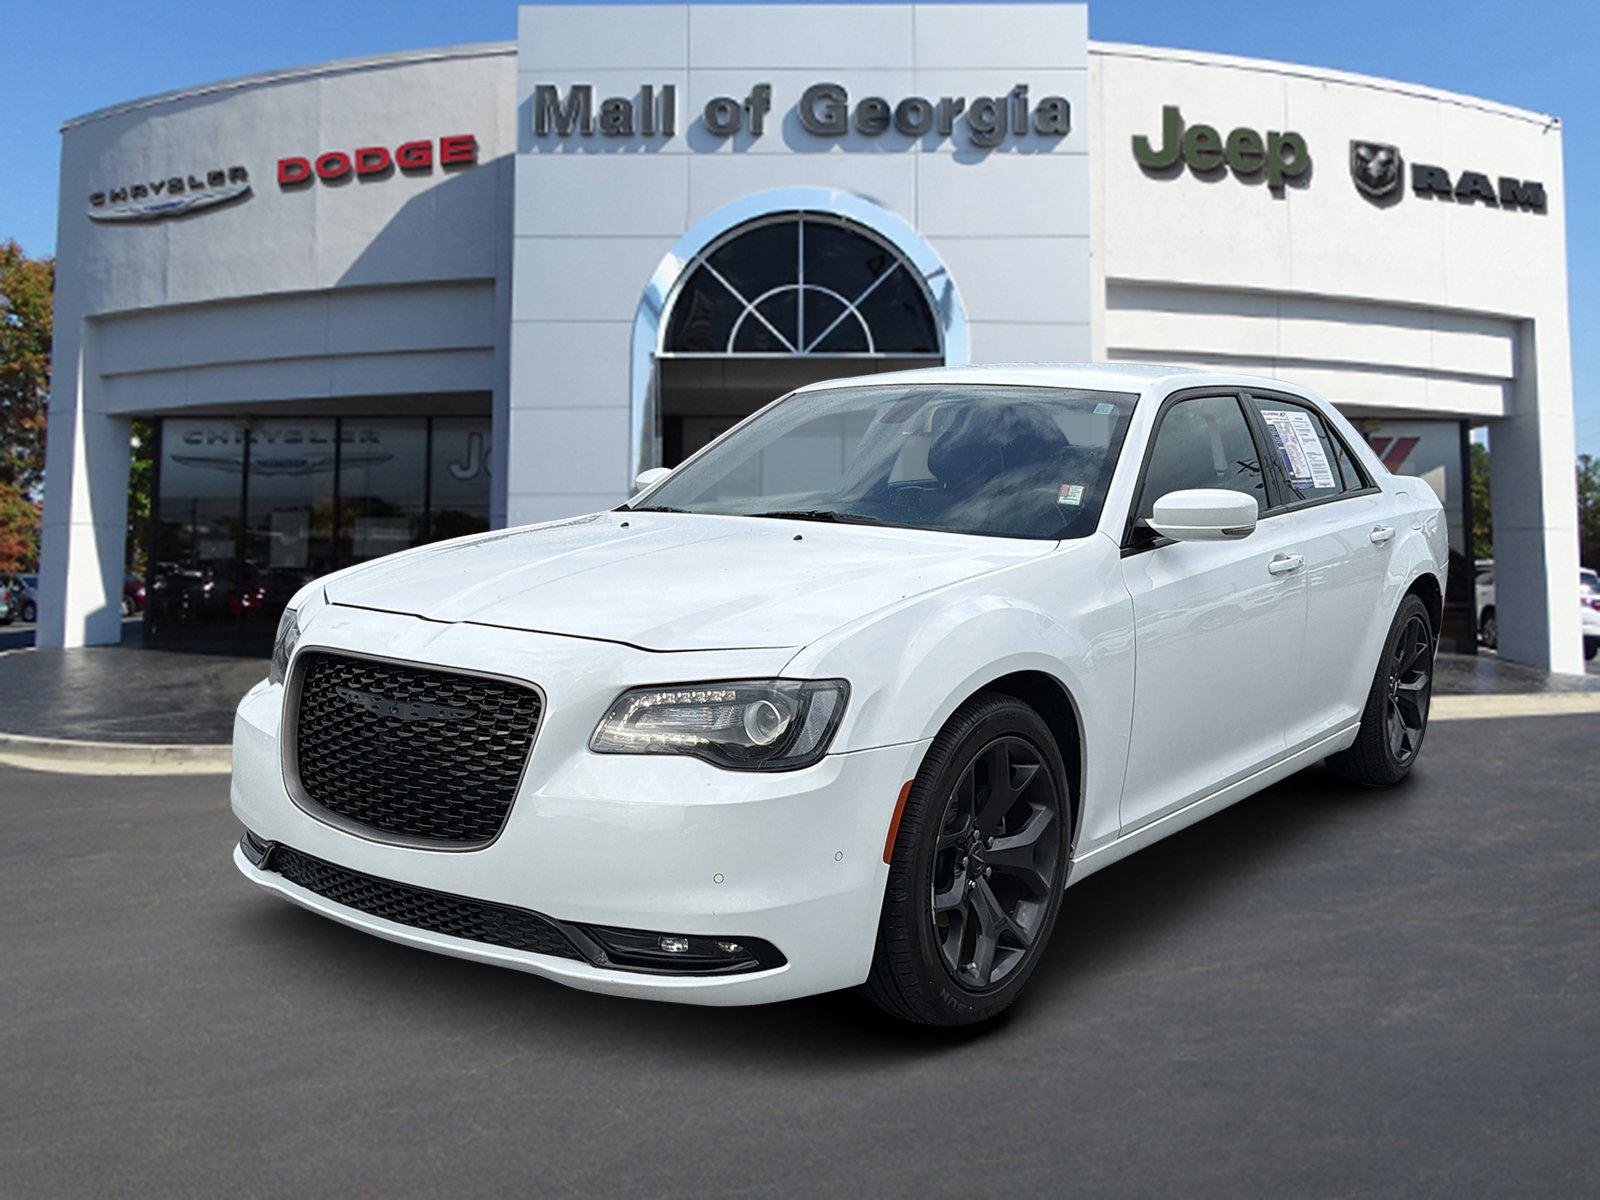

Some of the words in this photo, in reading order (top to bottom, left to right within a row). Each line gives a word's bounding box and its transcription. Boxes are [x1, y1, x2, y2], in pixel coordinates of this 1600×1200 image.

[532, 84, 676, 137] Mall
[704, 84, 772, 137] of
[799, 83, 1072, 147] Georgia
[277, 134, 478, 188] DODGE
[1131, 104, 1310, 192] Jeep
[90, 166, 249, 207] CHRYSLER
[1411, 163, 1546, 214] RAM
